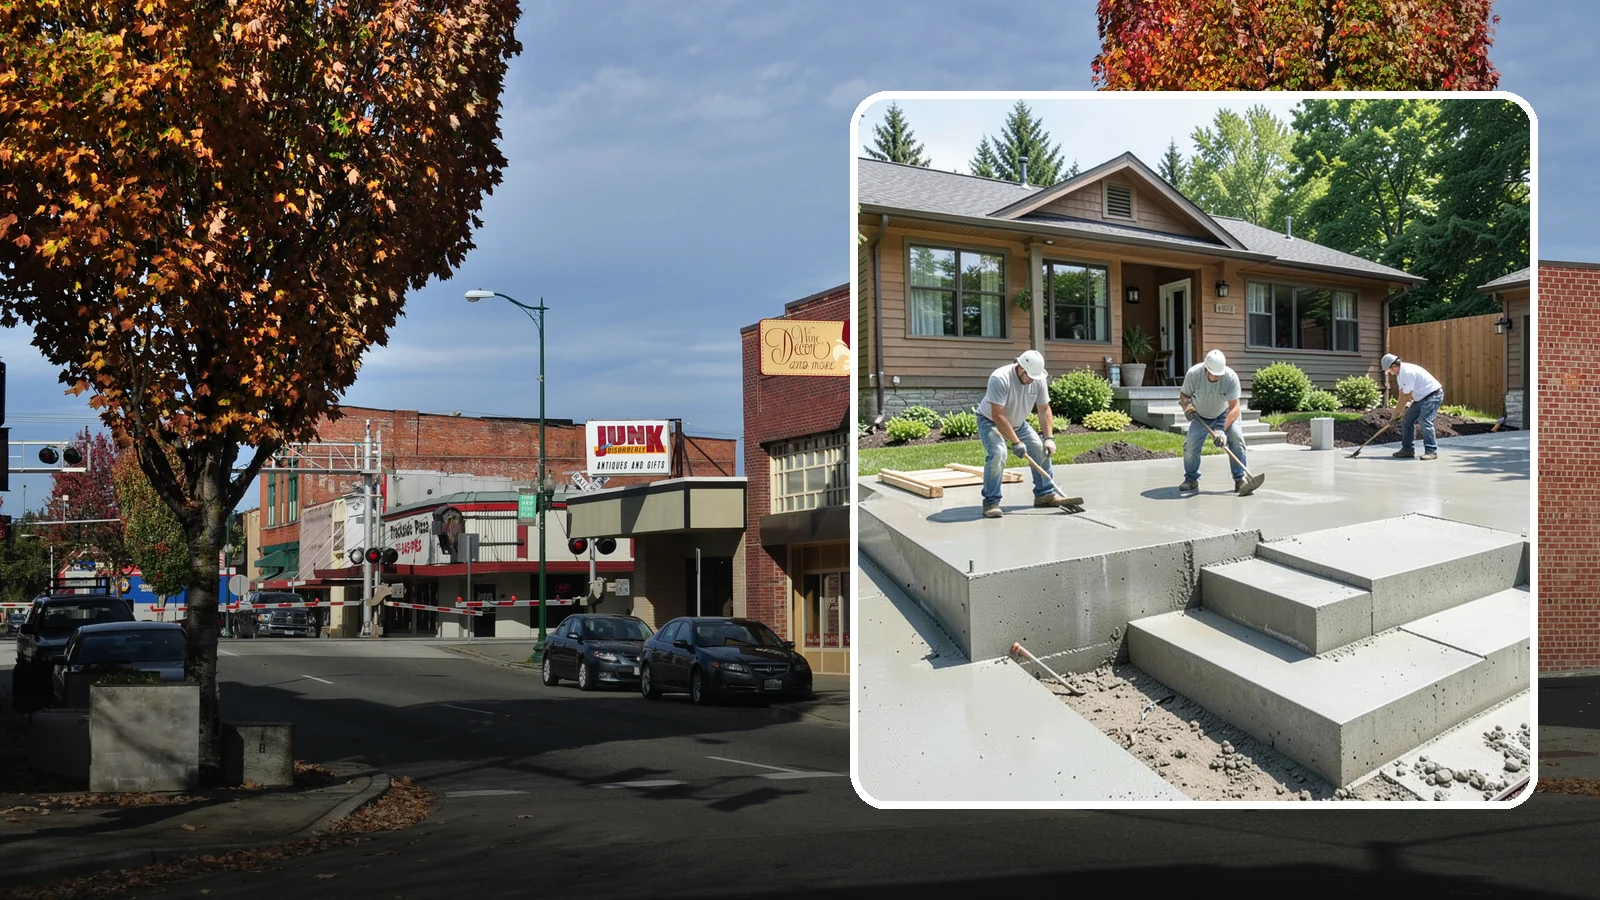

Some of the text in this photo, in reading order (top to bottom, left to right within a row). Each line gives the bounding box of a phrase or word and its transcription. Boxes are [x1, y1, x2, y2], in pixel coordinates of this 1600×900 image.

[595, 425, 665, 457] JUNK
[597, 460, 665, 470] ANTIQUES AND GIFTS
[414, 520, 429, 535] Pizza
